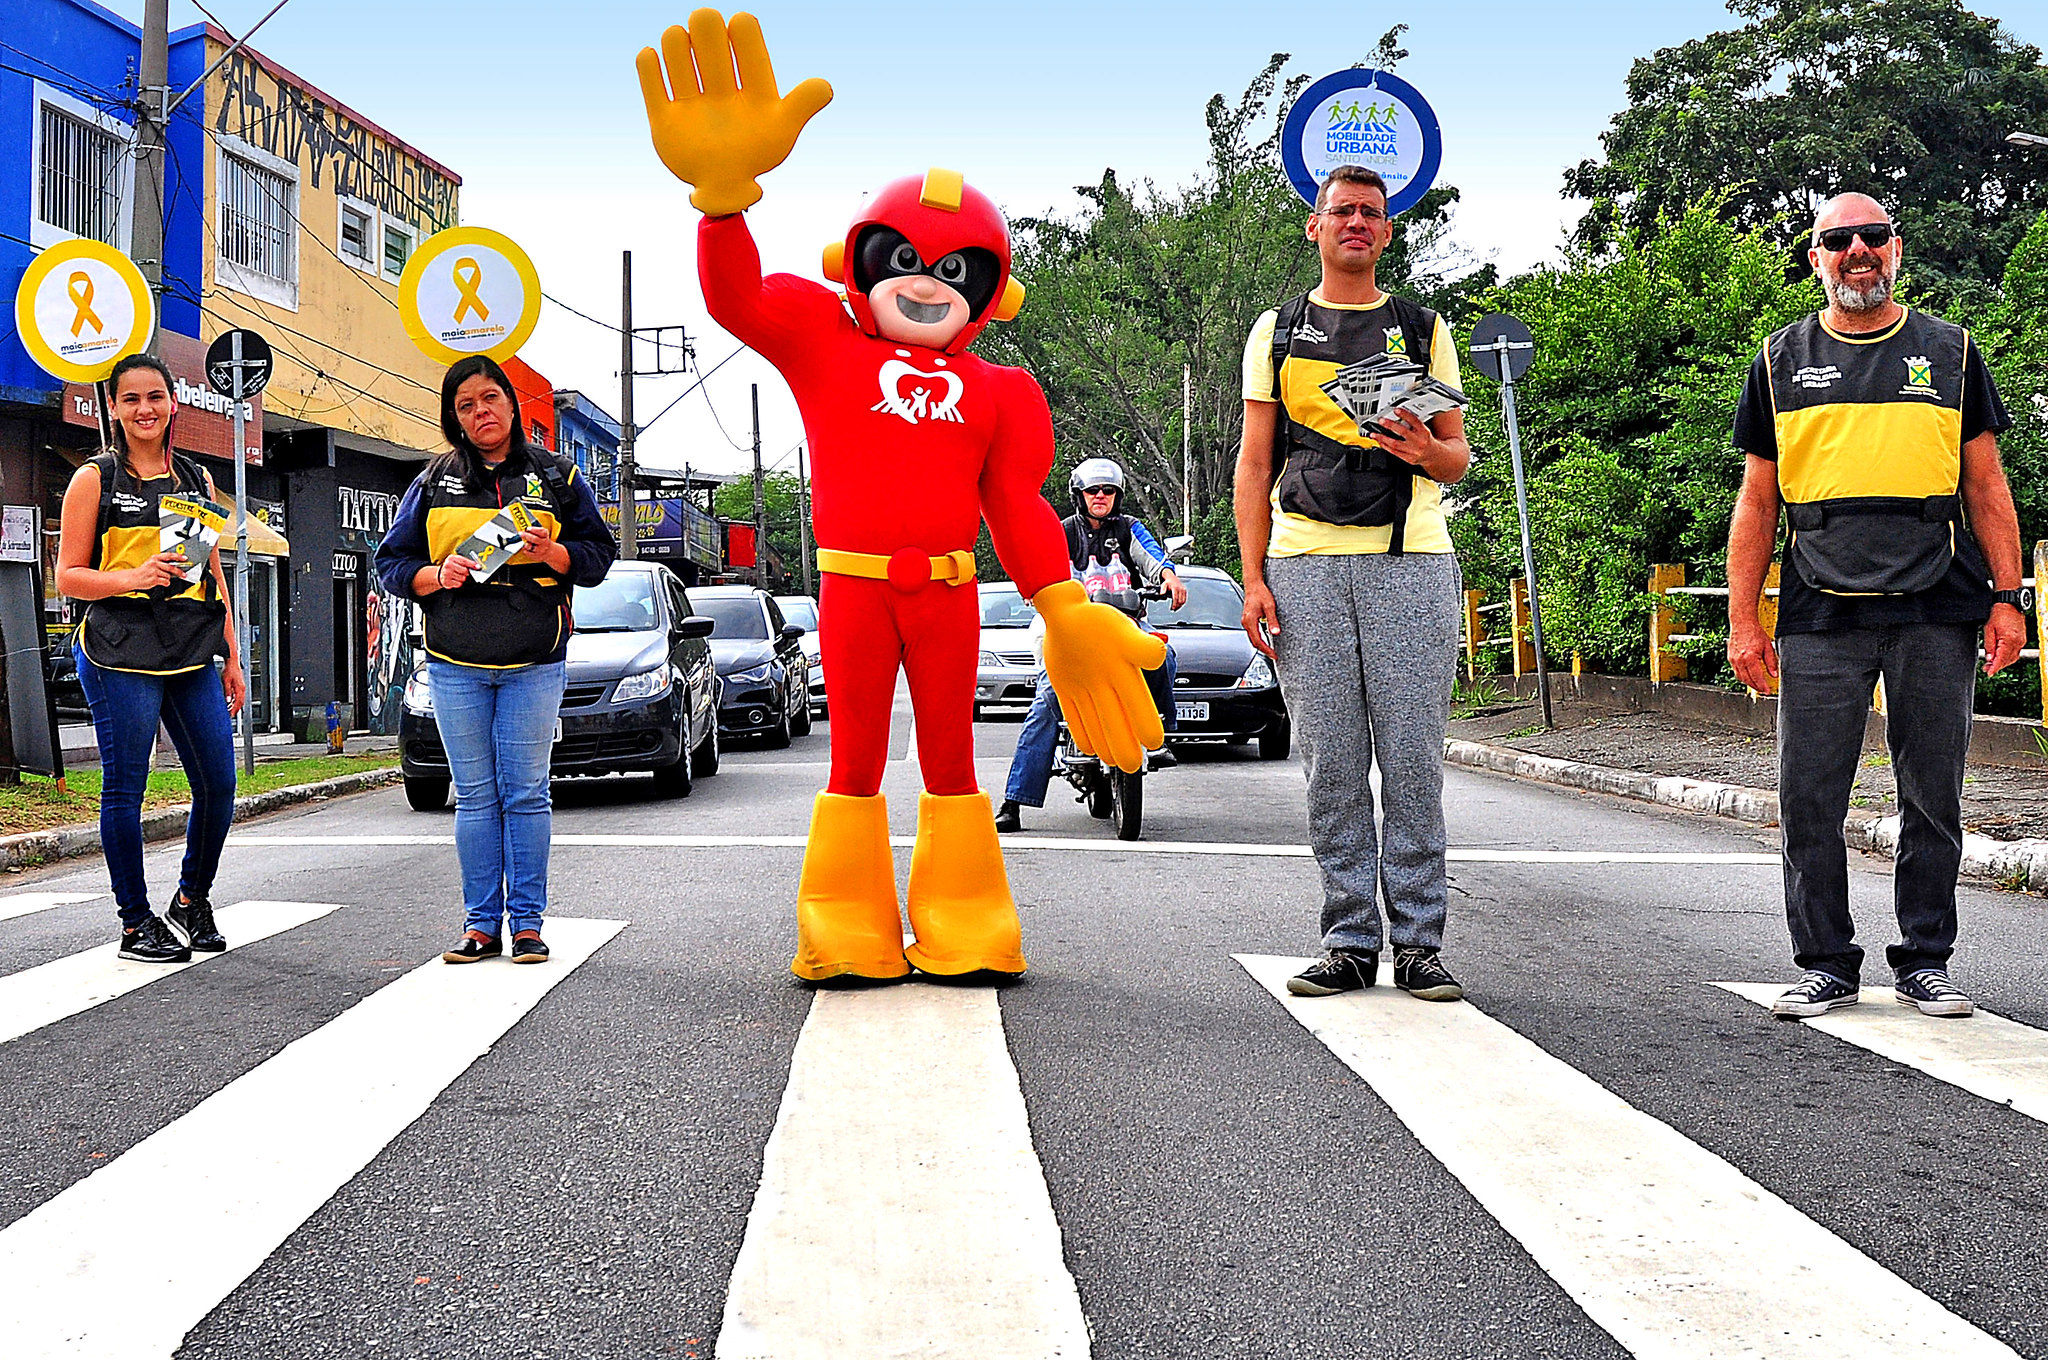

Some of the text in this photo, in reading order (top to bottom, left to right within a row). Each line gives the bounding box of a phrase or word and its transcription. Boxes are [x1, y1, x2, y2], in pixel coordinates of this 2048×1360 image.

[1326, 131, 1397, 143] MOBILIDADE
[1326, 141, 1398, 156] URBANA
[1325, 153, 1361, 163] SANTO
[1381, 171, 1408, 180] ânsito
[1175, 708, 1205, 720] -1136
